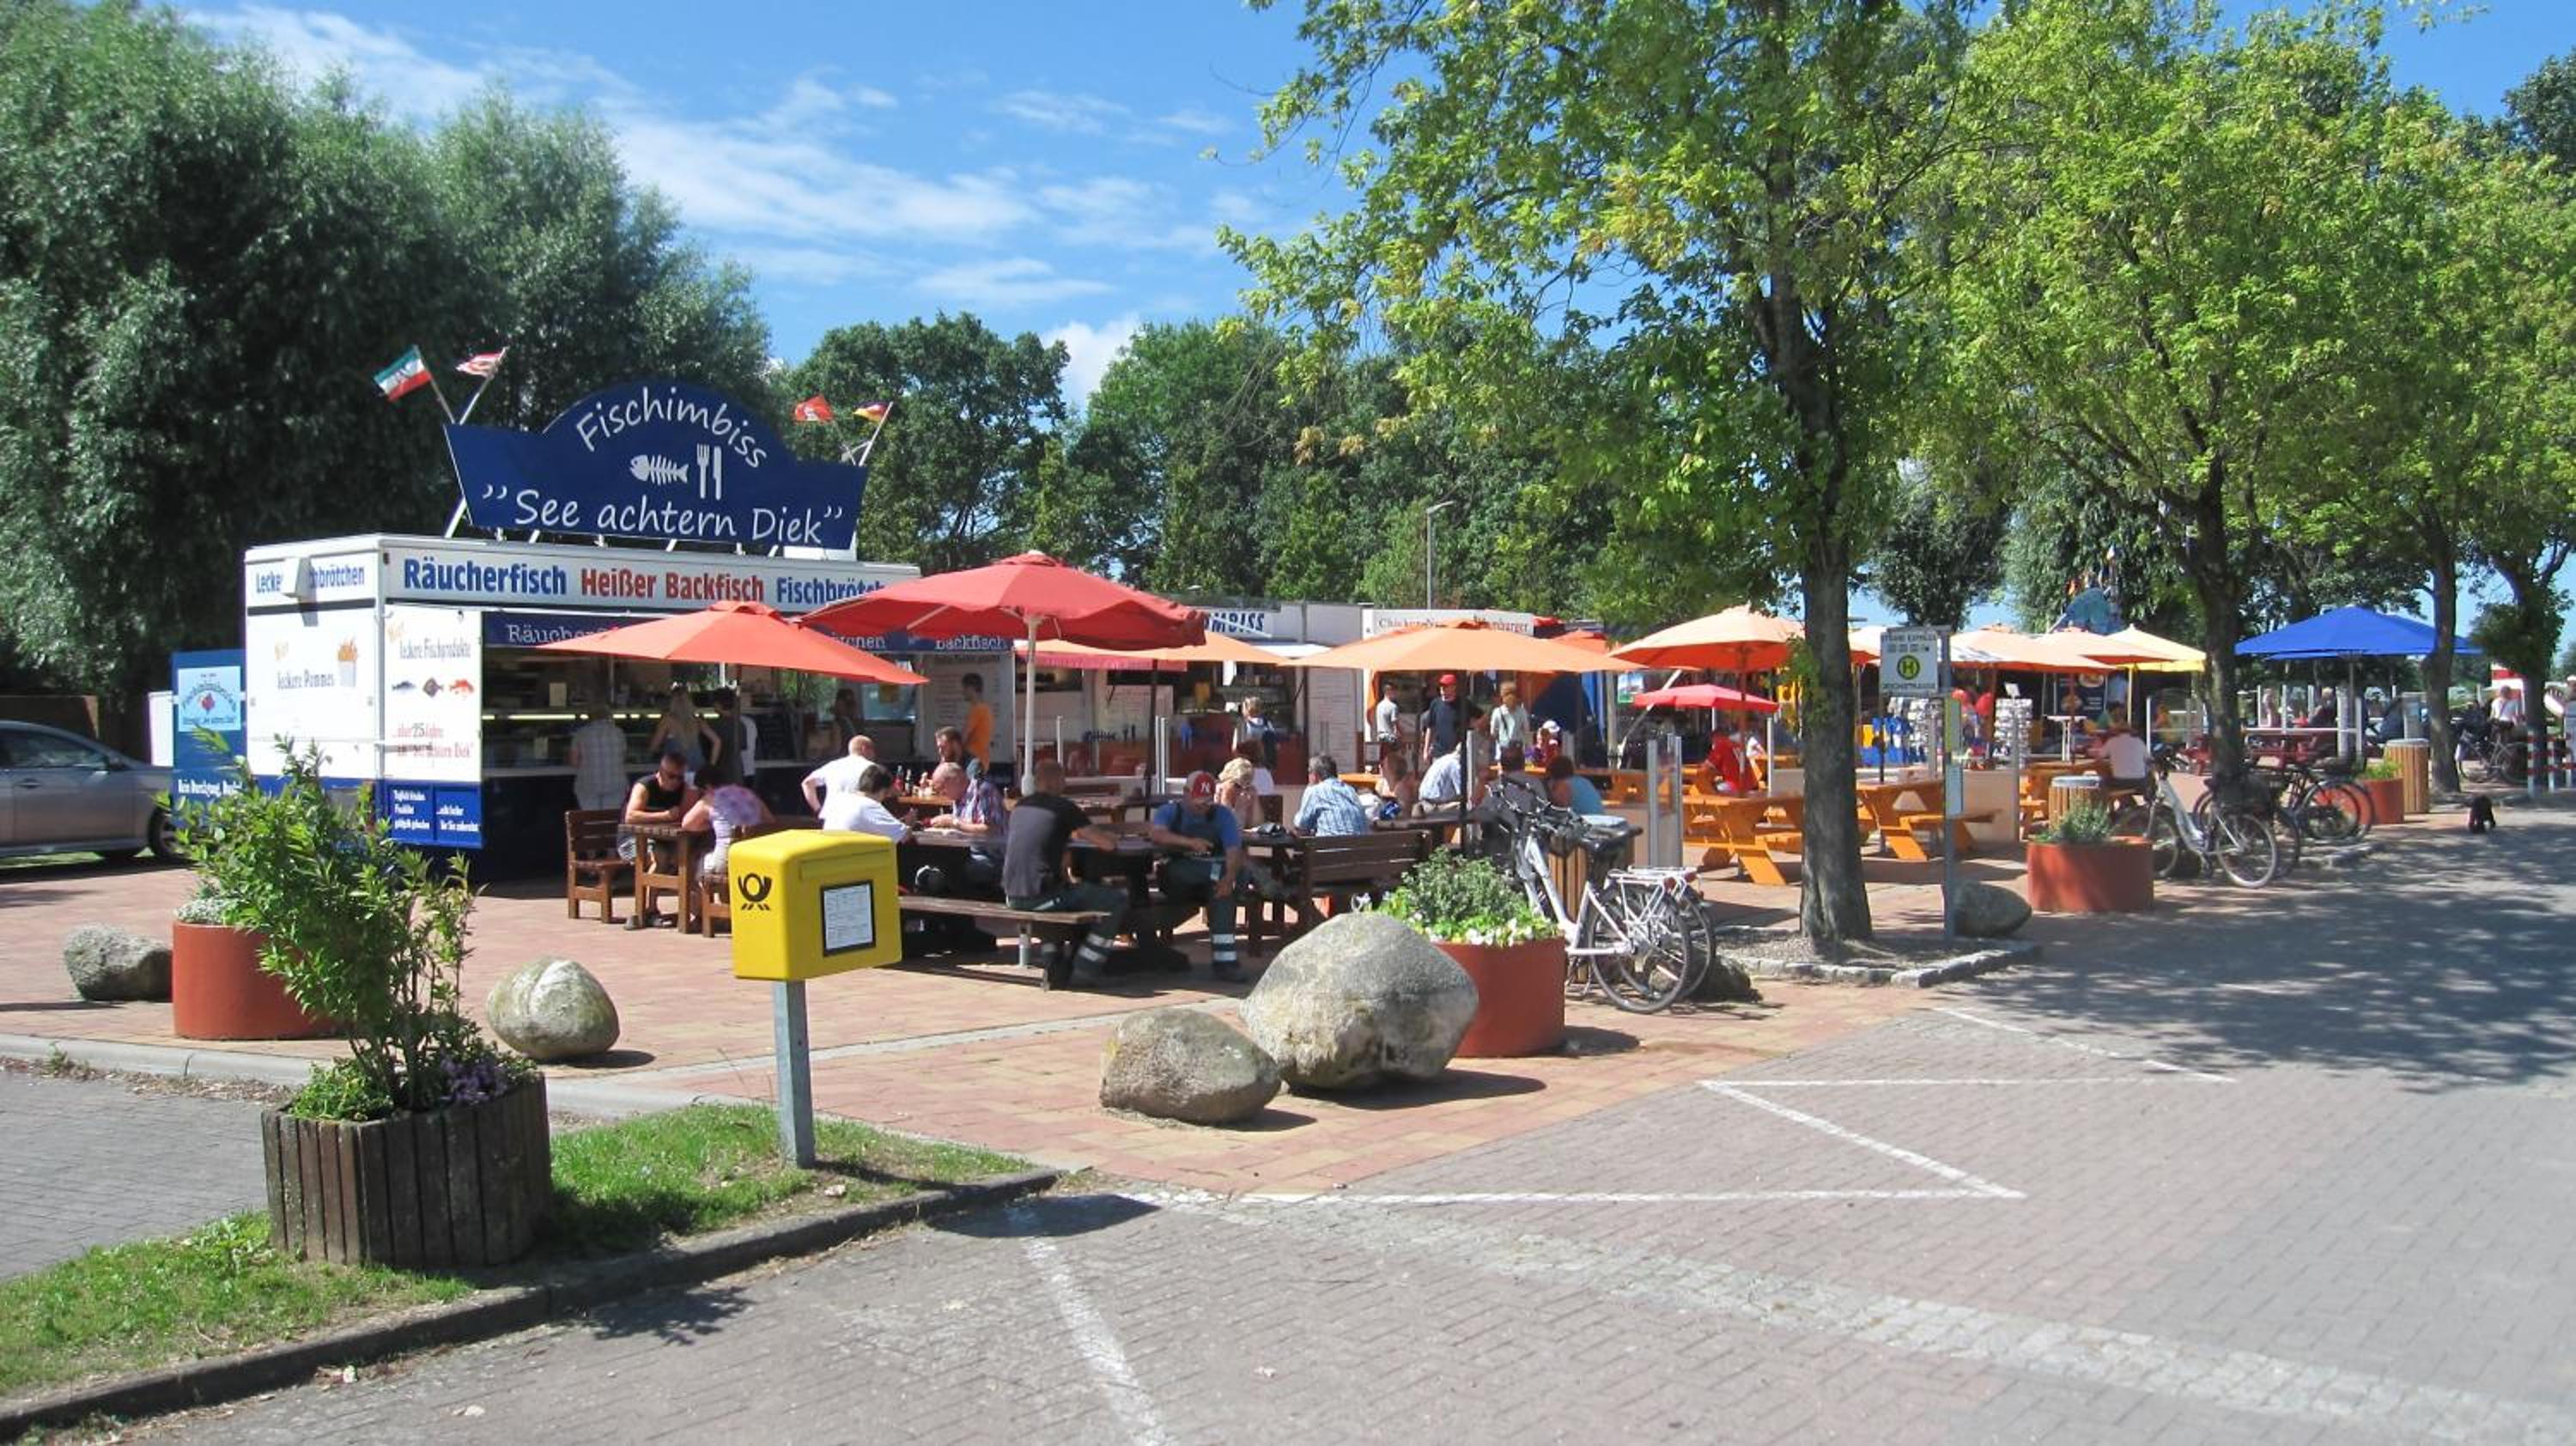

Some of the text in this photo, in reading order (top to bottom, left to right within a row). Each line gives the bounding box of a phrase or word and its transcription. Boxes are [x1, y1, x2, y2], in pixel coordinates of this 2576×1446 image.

[576, 386, 768, 469] Fischimbiss
[598, 495, 737, 538] achtern
[404, 556, 567, 594] Räucherfisch
[581, 568, 658, 599] Heißer
[665, 573, 765, 602] Backfisch
[1902, 661, 1915, 674] H
